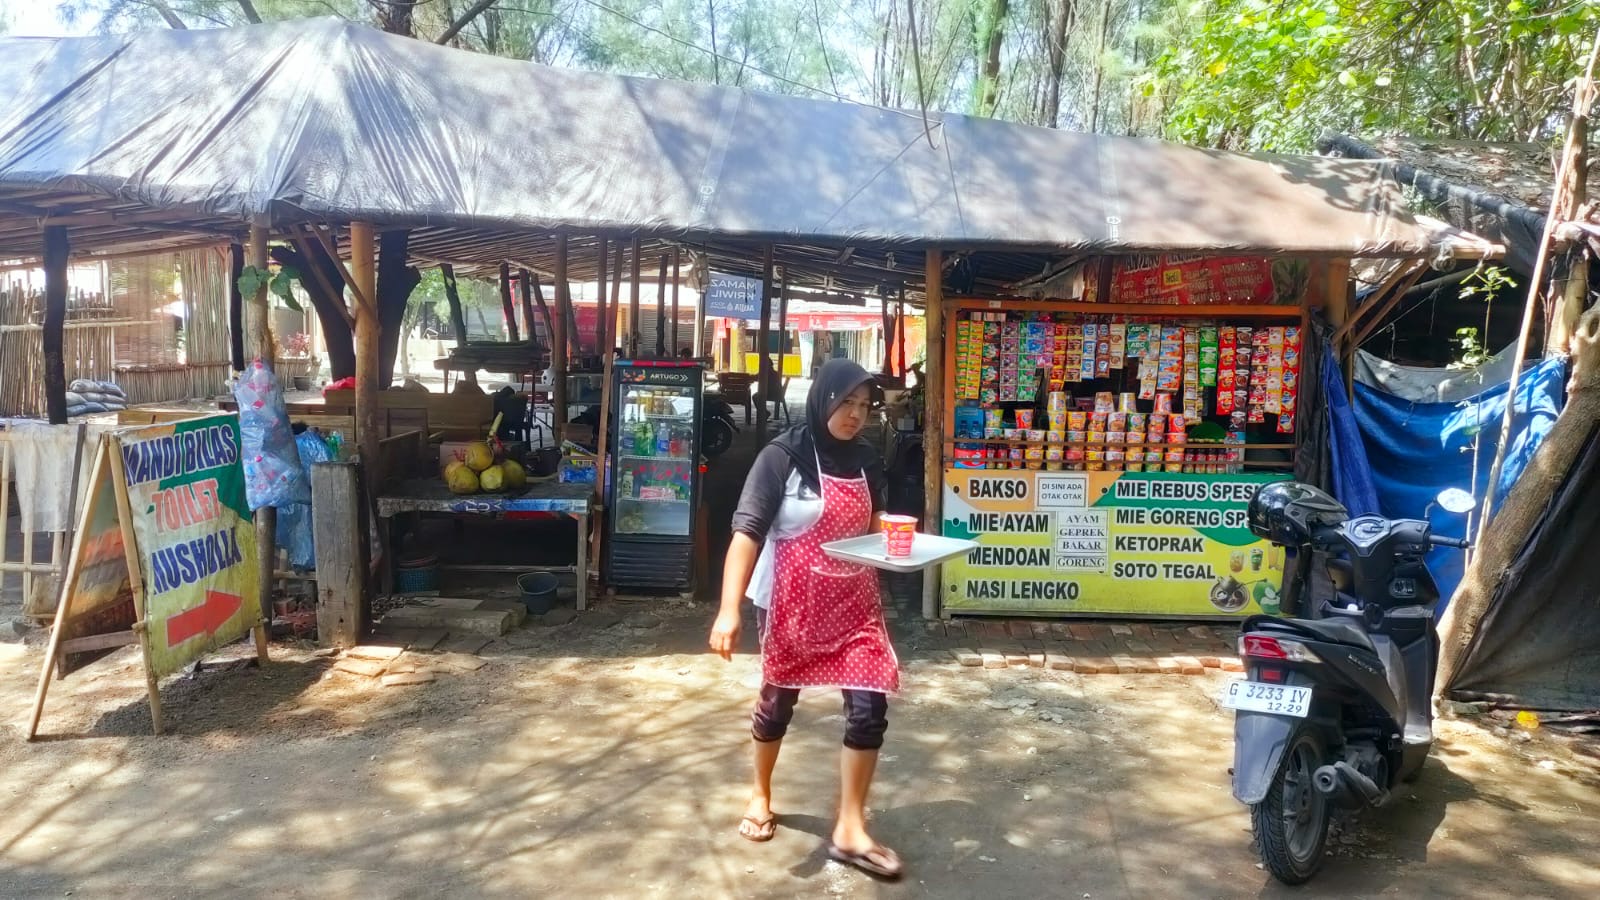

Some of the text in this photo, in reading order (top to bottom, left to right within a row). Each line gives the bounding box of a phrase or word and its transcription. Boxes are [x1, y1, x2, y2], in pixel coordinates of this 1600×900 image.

[123, 425, 237, 486] MANDI BILAS
[969, 479, 1027, 499] BAKSO
[1117, 481, 1147, 497] MIE
[1151, 482, 1207, 499] REBUS
[151, 478, 221, 533] TOILET
[969, 512, 1049, 533] MIE AYAM
[1065, 515, 1100, 524] AYAM
[1116, 509, 1145, 525] MIE
[1150, 510, 1220, 526] GORENG
[1059, 528, 1105, 537] GEPREK
[1062, 541, 1102, 550] BAKAR
[1115, 536, 1204, 553] KETOPRAK
[968, 547, 1050, 567] MENDOAN
[1057, 557, 1105, 568] GORENG
[1114, 562, 1216, 580] SOTO TEGAL
[966, 580, 1080, 600] NASI LENGKO
[1229, 682, 1308, 703] G 3233 IY
